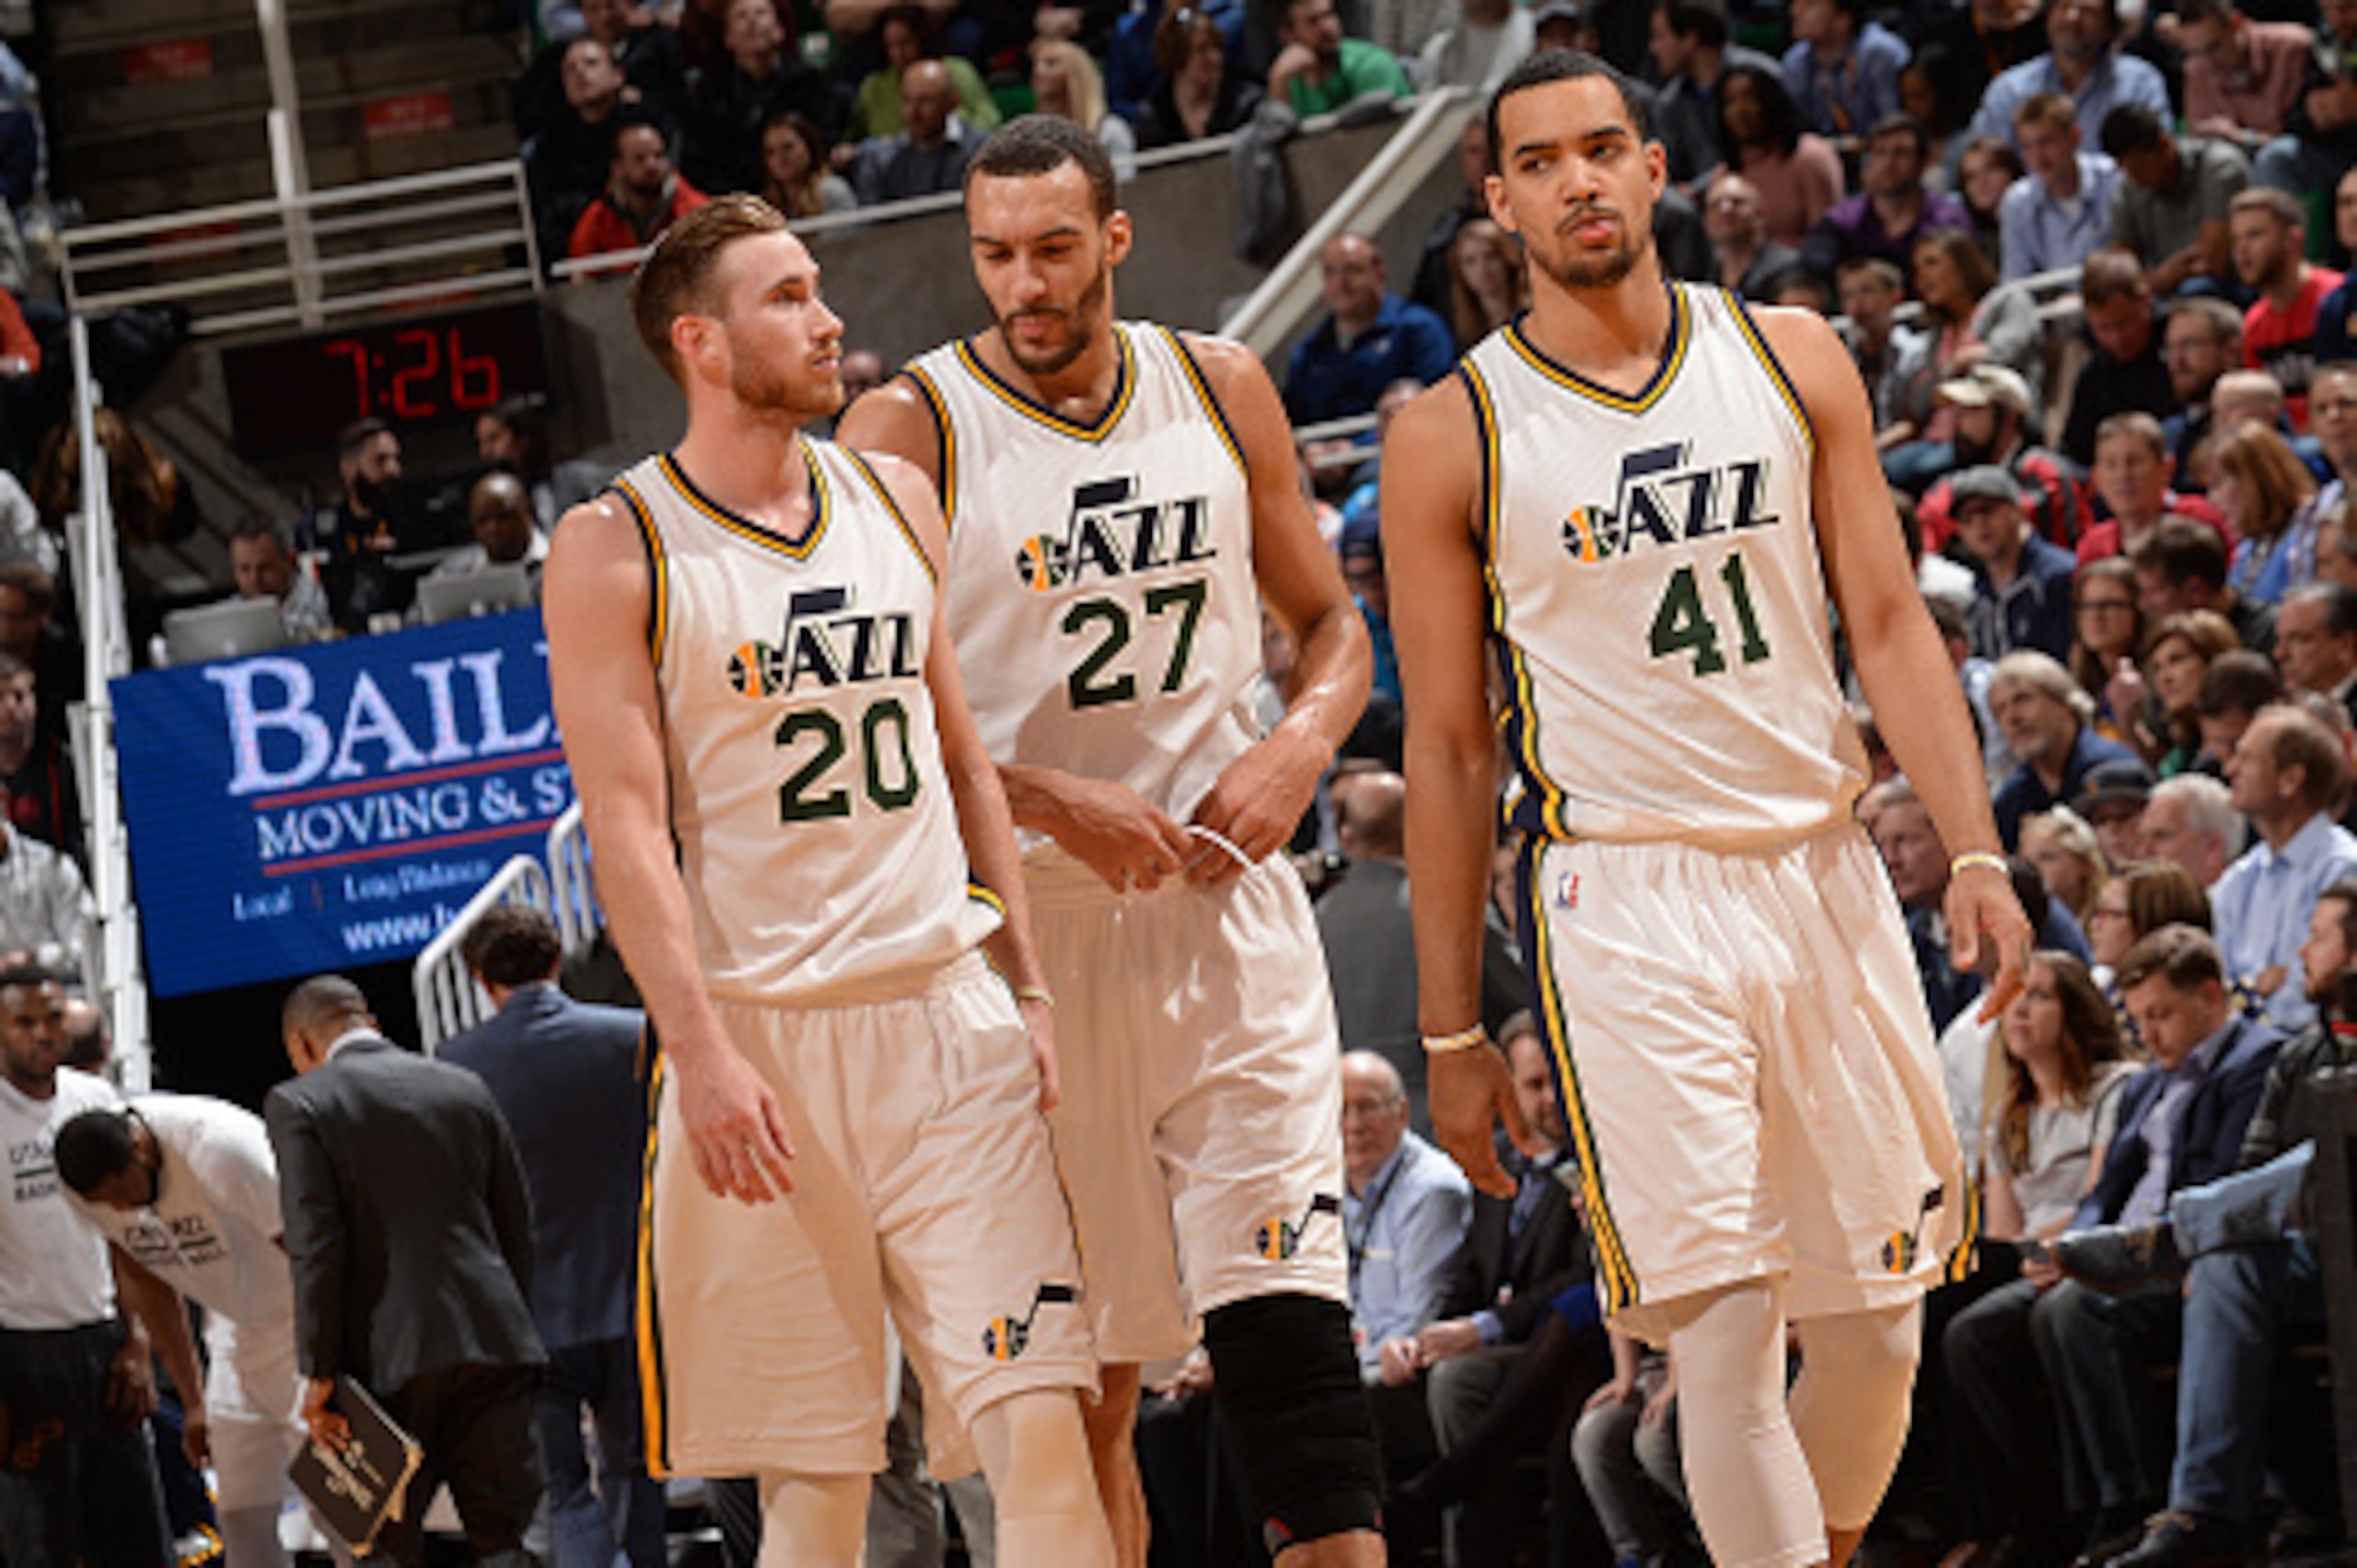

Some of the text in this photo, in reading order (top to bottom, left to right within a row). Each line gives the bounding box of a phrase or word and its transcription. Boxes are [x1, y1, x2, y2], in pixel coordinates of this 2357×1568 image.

[325, 327, 502, 420] 7:26
[1016, 472, 1218, 592] JAZZ
[1562, 437, 1781, 564] JAZZ
[726, 582, 919, 700] JAZZ
[1062, 578, 1207, 711] 27
[1646, 552, 1771, 677] 41
[203, 642, 563, 796] BAIL
[775, 698, 921, 822] 20
[255, 764, 571, 861] MOVING & S
